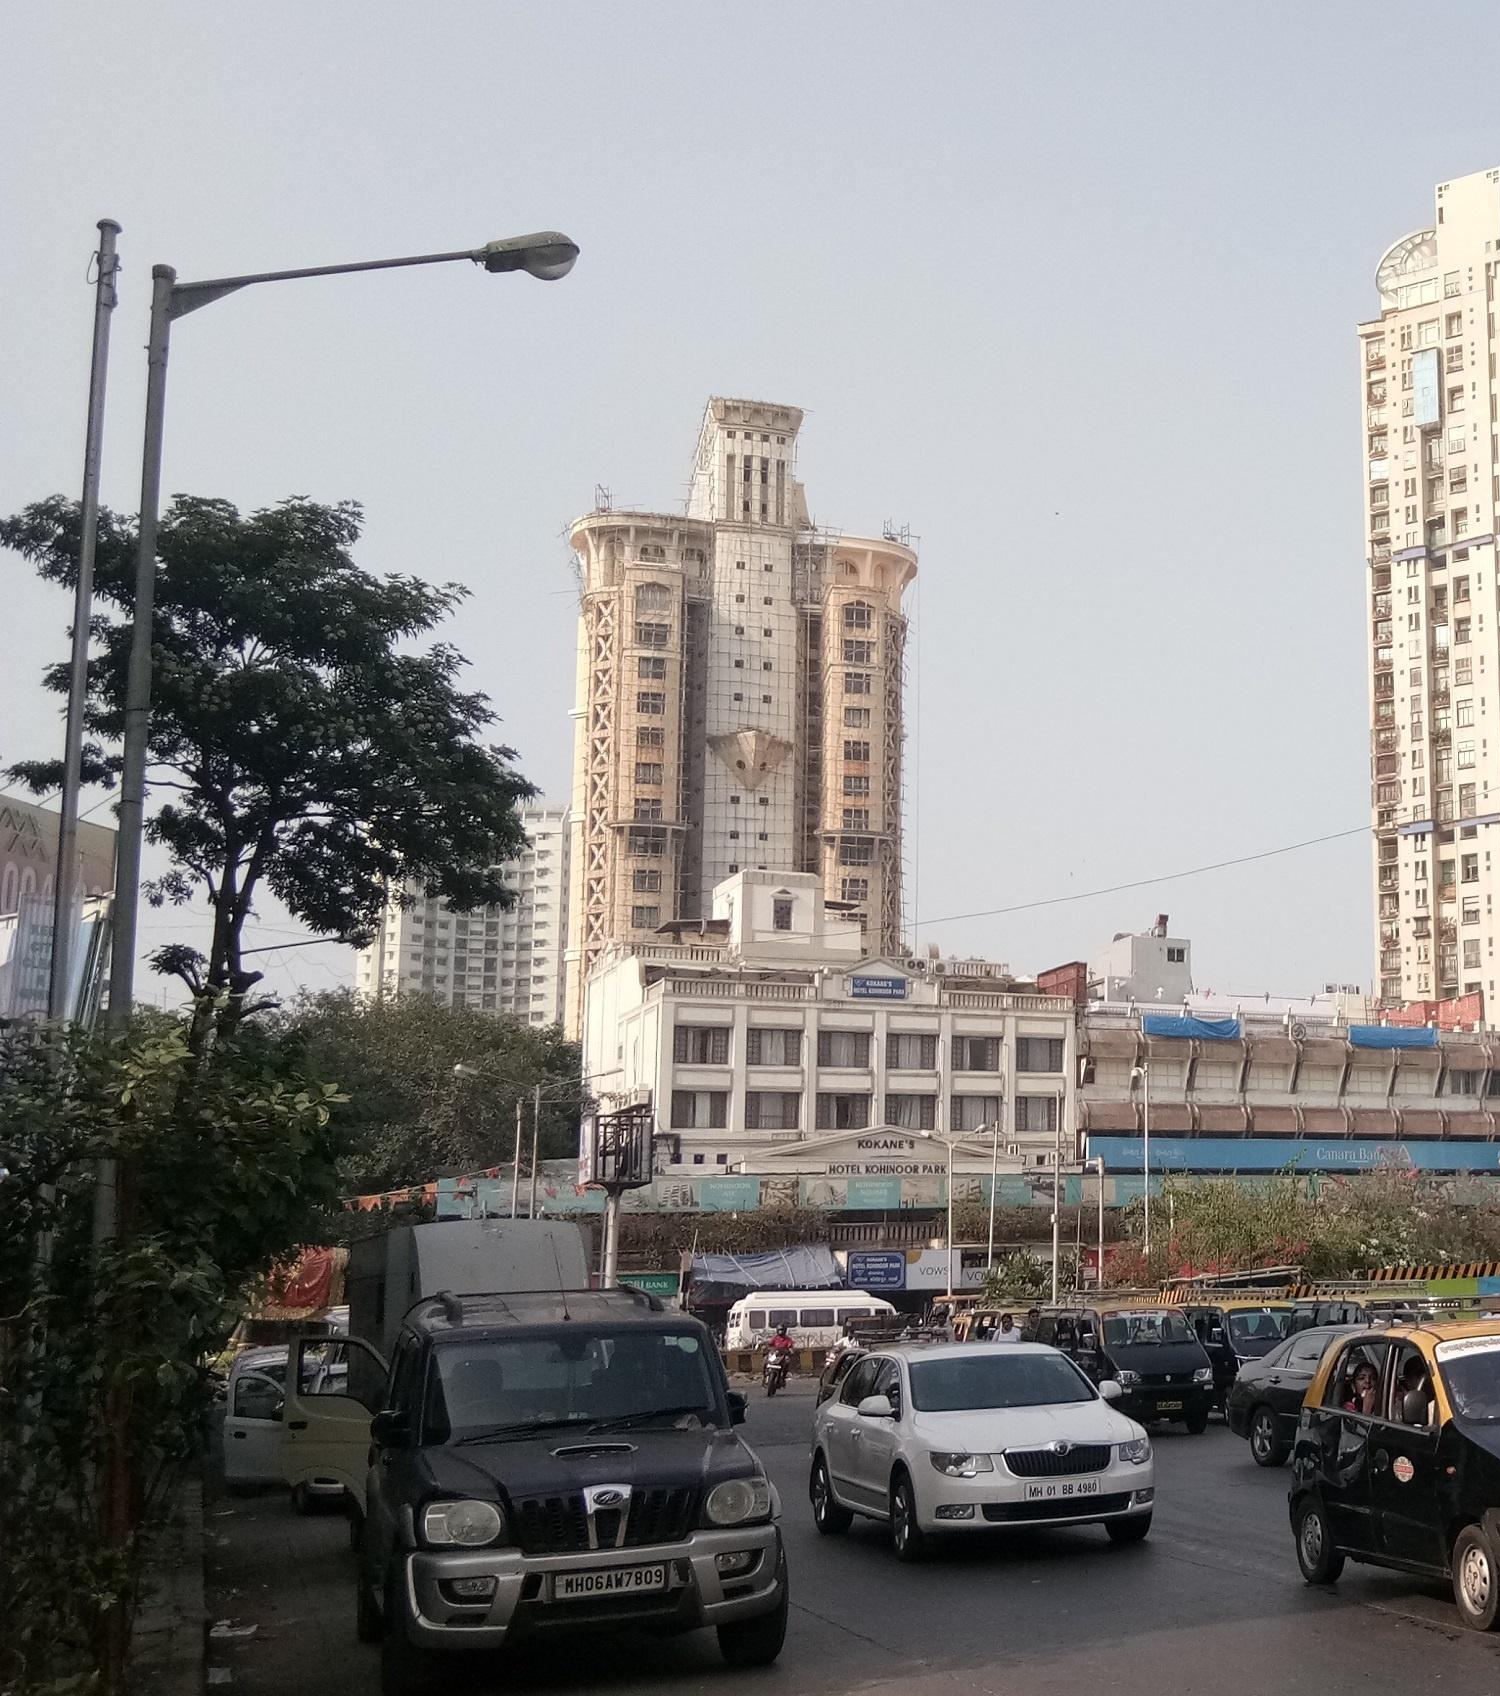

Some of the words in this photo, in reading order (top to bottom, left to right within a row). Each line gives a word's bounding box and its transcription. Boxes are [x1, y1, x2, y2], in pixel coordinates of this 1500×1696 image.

[857, 1139, 915, 1150] KOKANE'S
[1316, 1147, 1356, 1161] Canara
[829, 1164, 861, 1175] HOTEL
[865, 1164, 919, 1175] KOHINOOR
[922, 1164, 947, 1175] PARK
[645, 1281, 669, 1289] BANK
[1029, 1485, 1043, 1498] MH
[1047, 1486, 1056, 1496] 01
[565, 1569, 663, 1594] MH06AW7809
